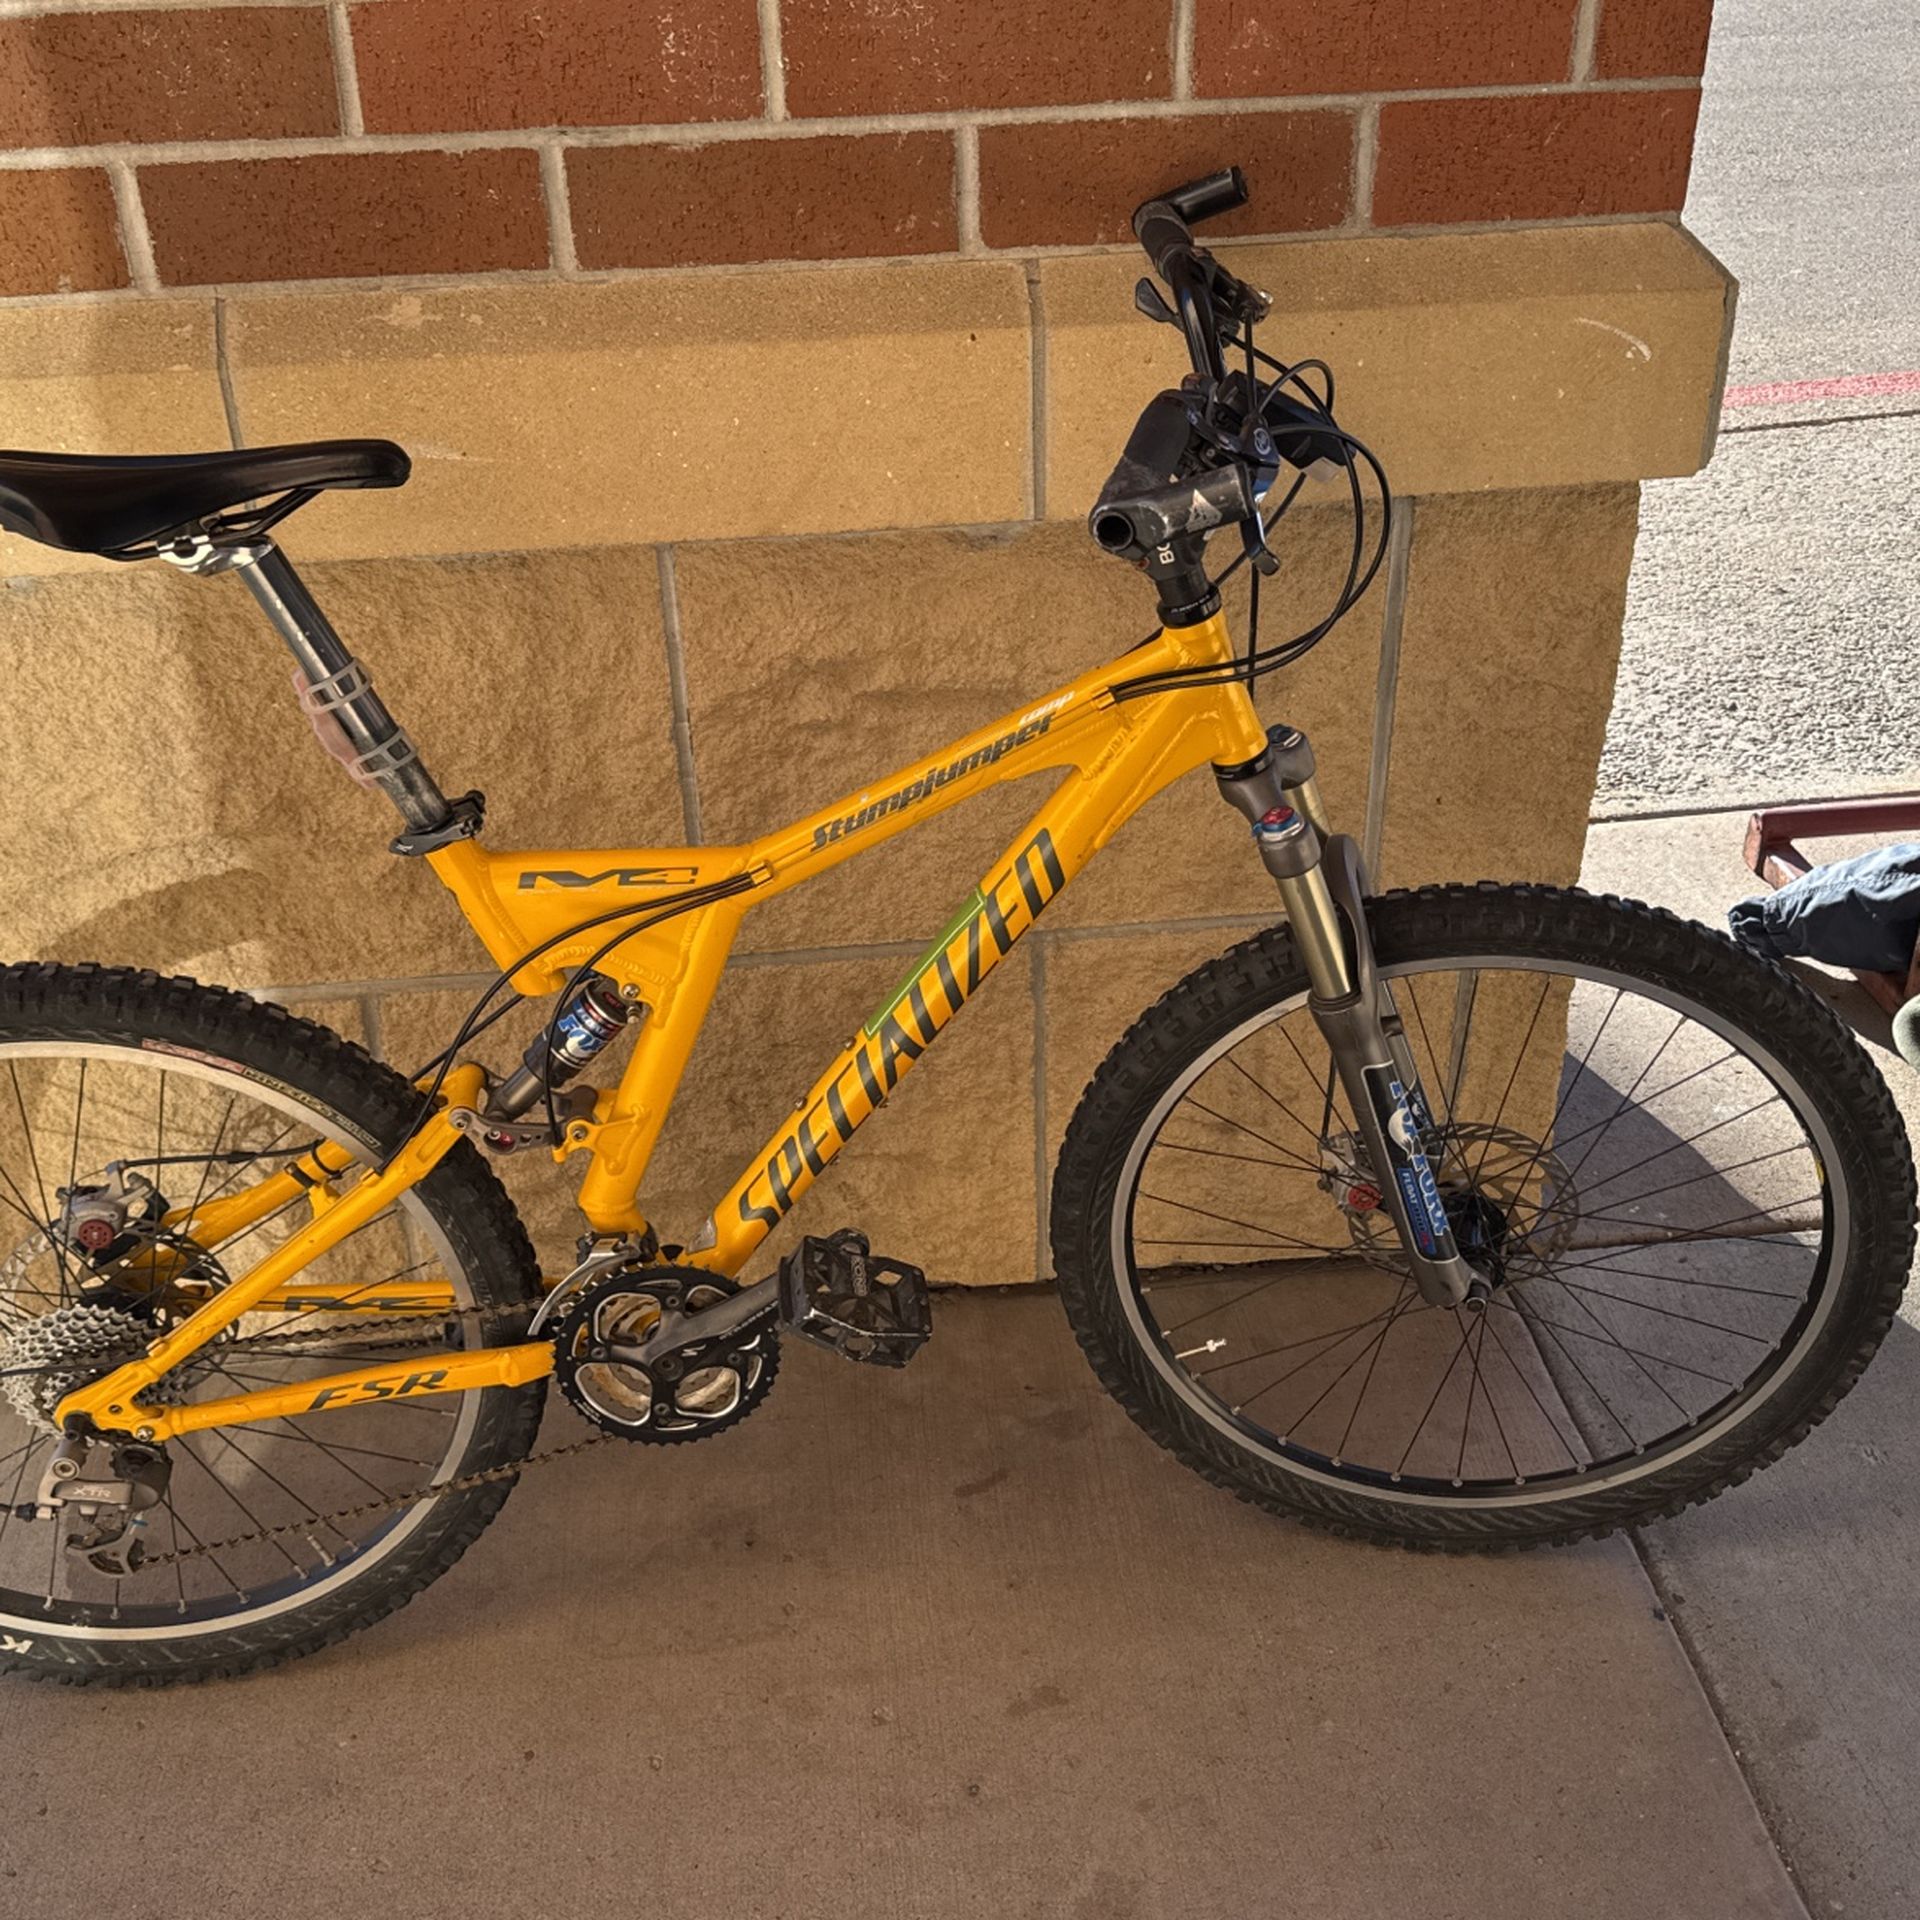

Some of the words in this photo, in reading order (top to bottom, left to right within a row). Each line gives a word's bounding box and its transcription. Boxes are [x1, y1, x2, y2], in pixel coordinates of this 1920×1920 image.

[811, 711, 1057, 852] Stumpjumper
[739, 828, 1067, 1235] SPECIALIZED
[307, 1369, 449, 1411] FSR
[73, 1486, 112, 1498] XTR
